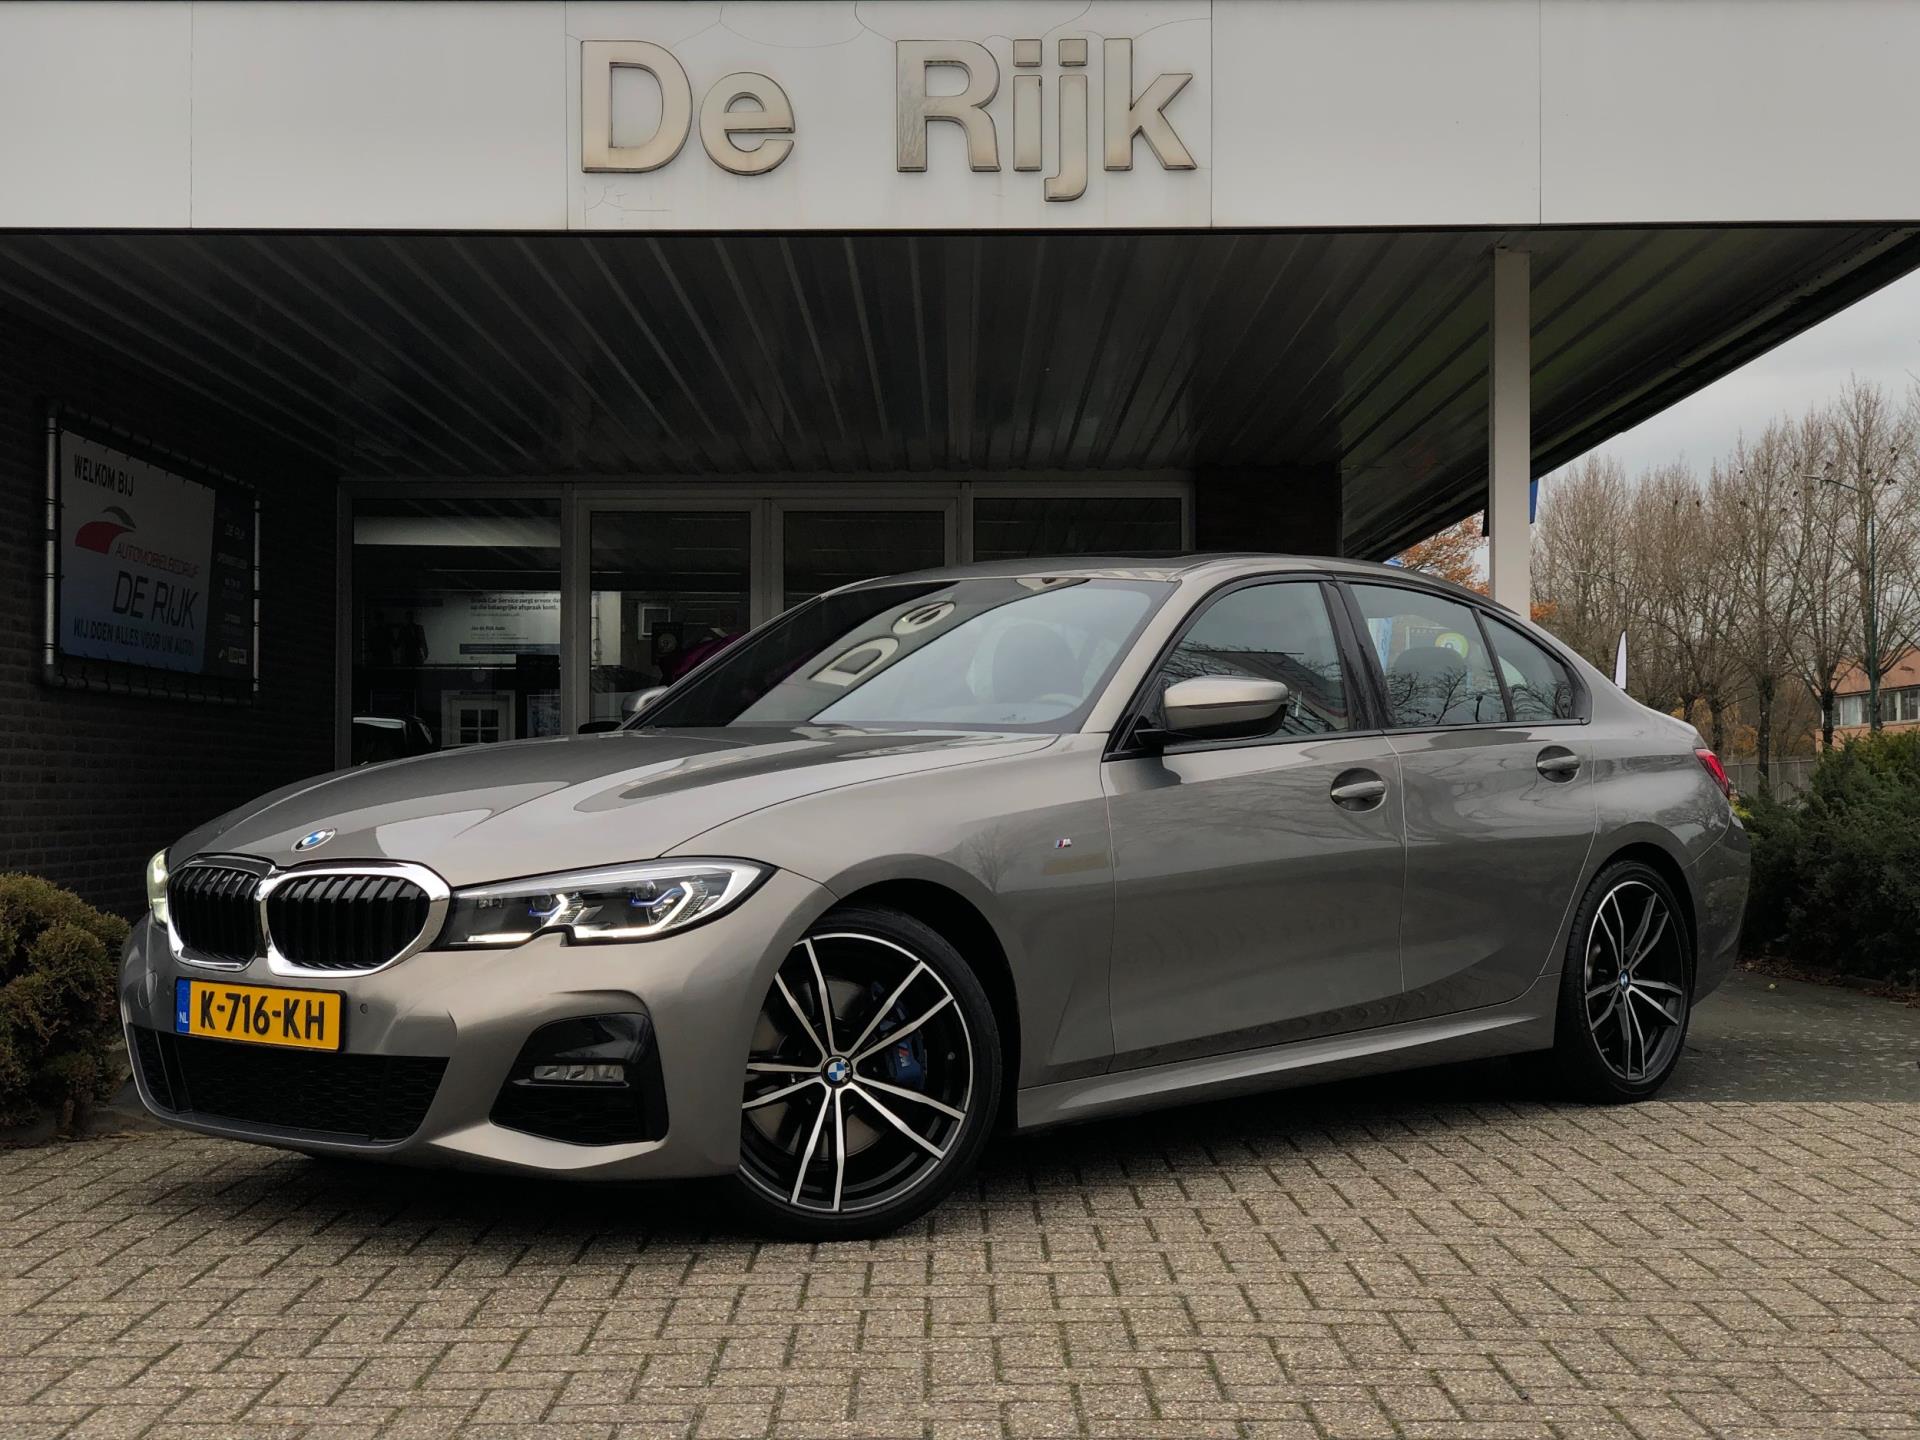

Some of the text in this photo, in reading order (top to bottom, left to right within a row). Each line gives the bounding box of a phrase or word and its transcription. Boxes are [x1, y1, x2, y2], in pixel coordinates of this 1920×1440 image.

[581, 38, 1198, 202] De Rijk
[74, 454, 135, 497] WELKOM BIJ
[112, 570, 200, 630] DE RIJK
[74, 616, 89, 640] WIJ
[90, 620, 113, 642] DOEN
[178, 1011, 189, 1024] NL
[200, 990, 325, 1041] K-716-KH
